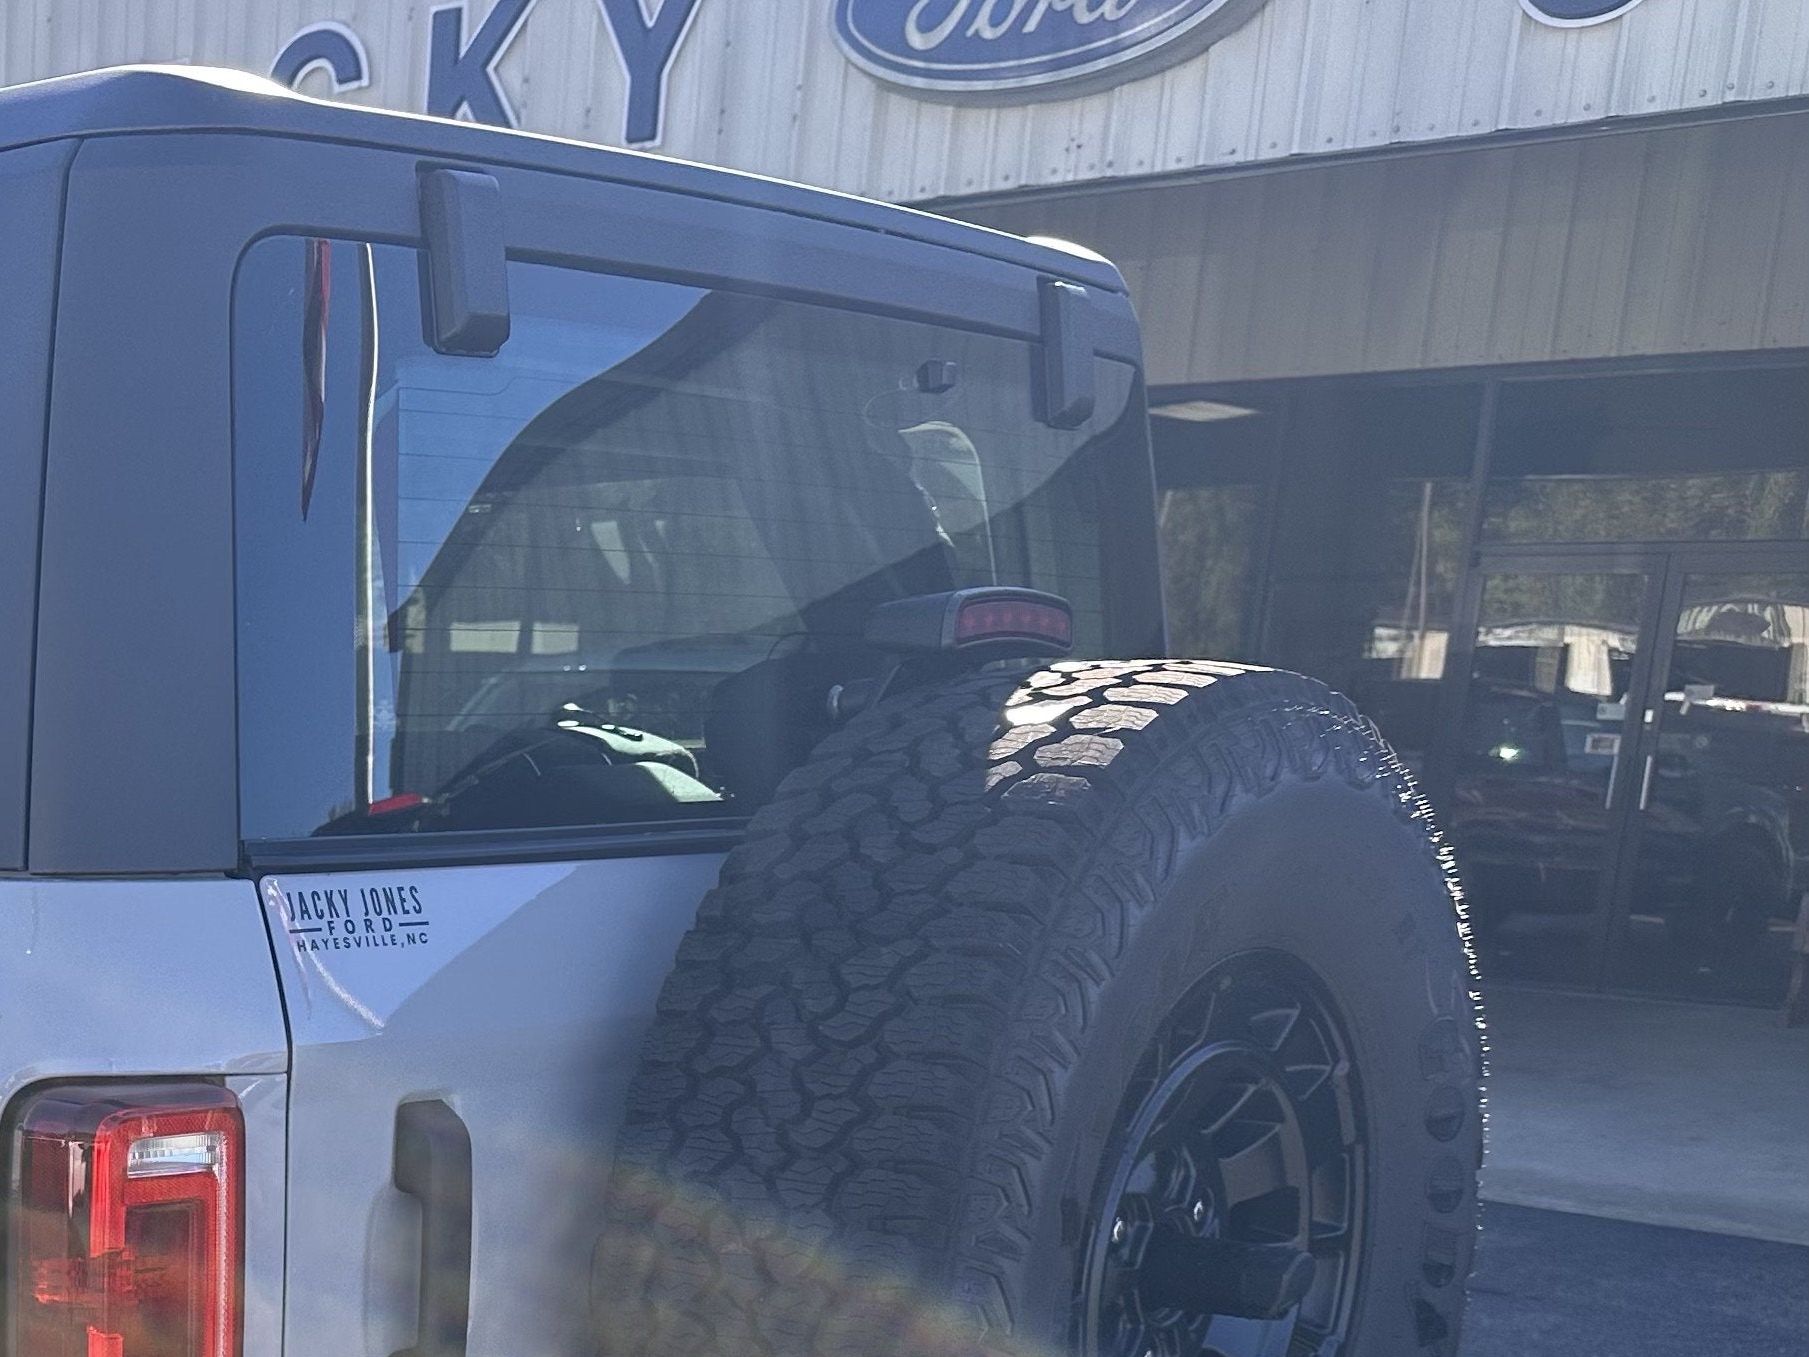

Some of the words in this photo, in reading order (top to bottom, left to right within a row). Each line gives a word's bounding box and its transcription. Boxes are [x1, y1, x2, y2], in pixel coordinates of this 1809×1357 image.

[286, 888, 351, 922] JACKY
[360, 885, 423, 917] JONES
[327, 917, 393, 936] FORD
